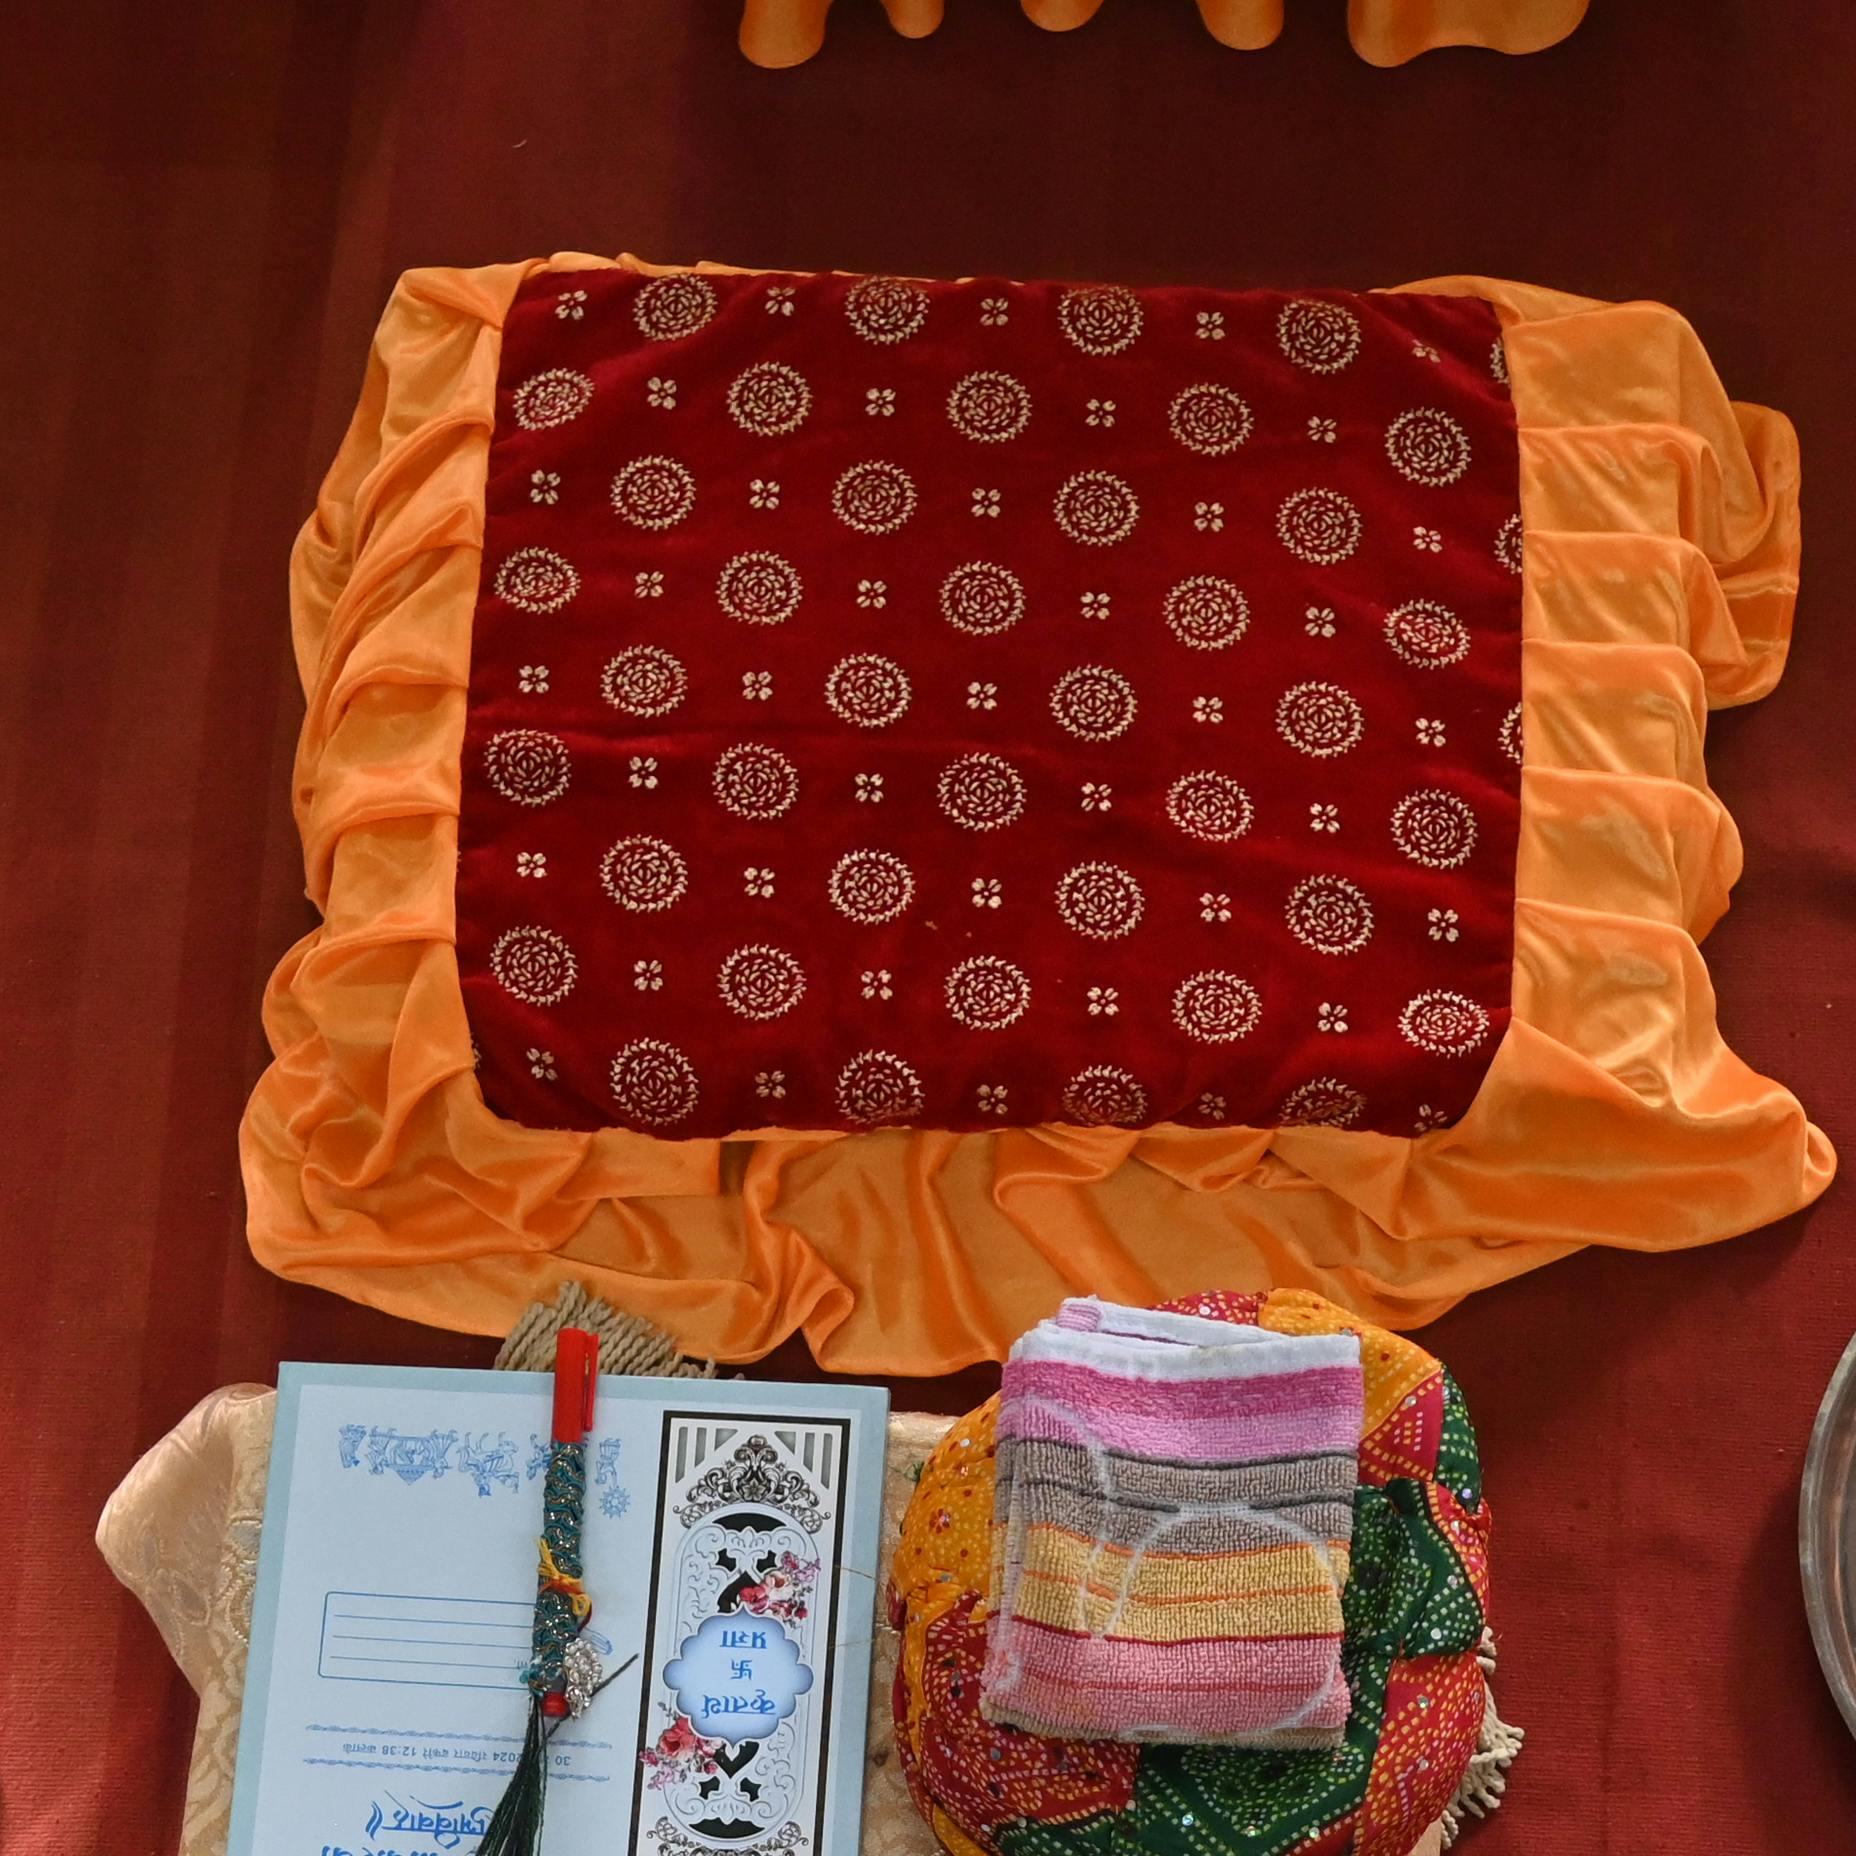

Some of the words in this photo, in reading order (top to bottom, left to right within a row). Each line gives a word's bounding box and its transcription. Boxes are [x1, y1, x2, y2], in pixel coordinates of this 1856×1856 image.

[719, 1630, 767, 1649] प्रज्ञा
[701, 1689, 776, 1719] कृतार्थ
[382, 1744, 416, 1756] 12:38
[554, 1754, 572, 1766] 30
